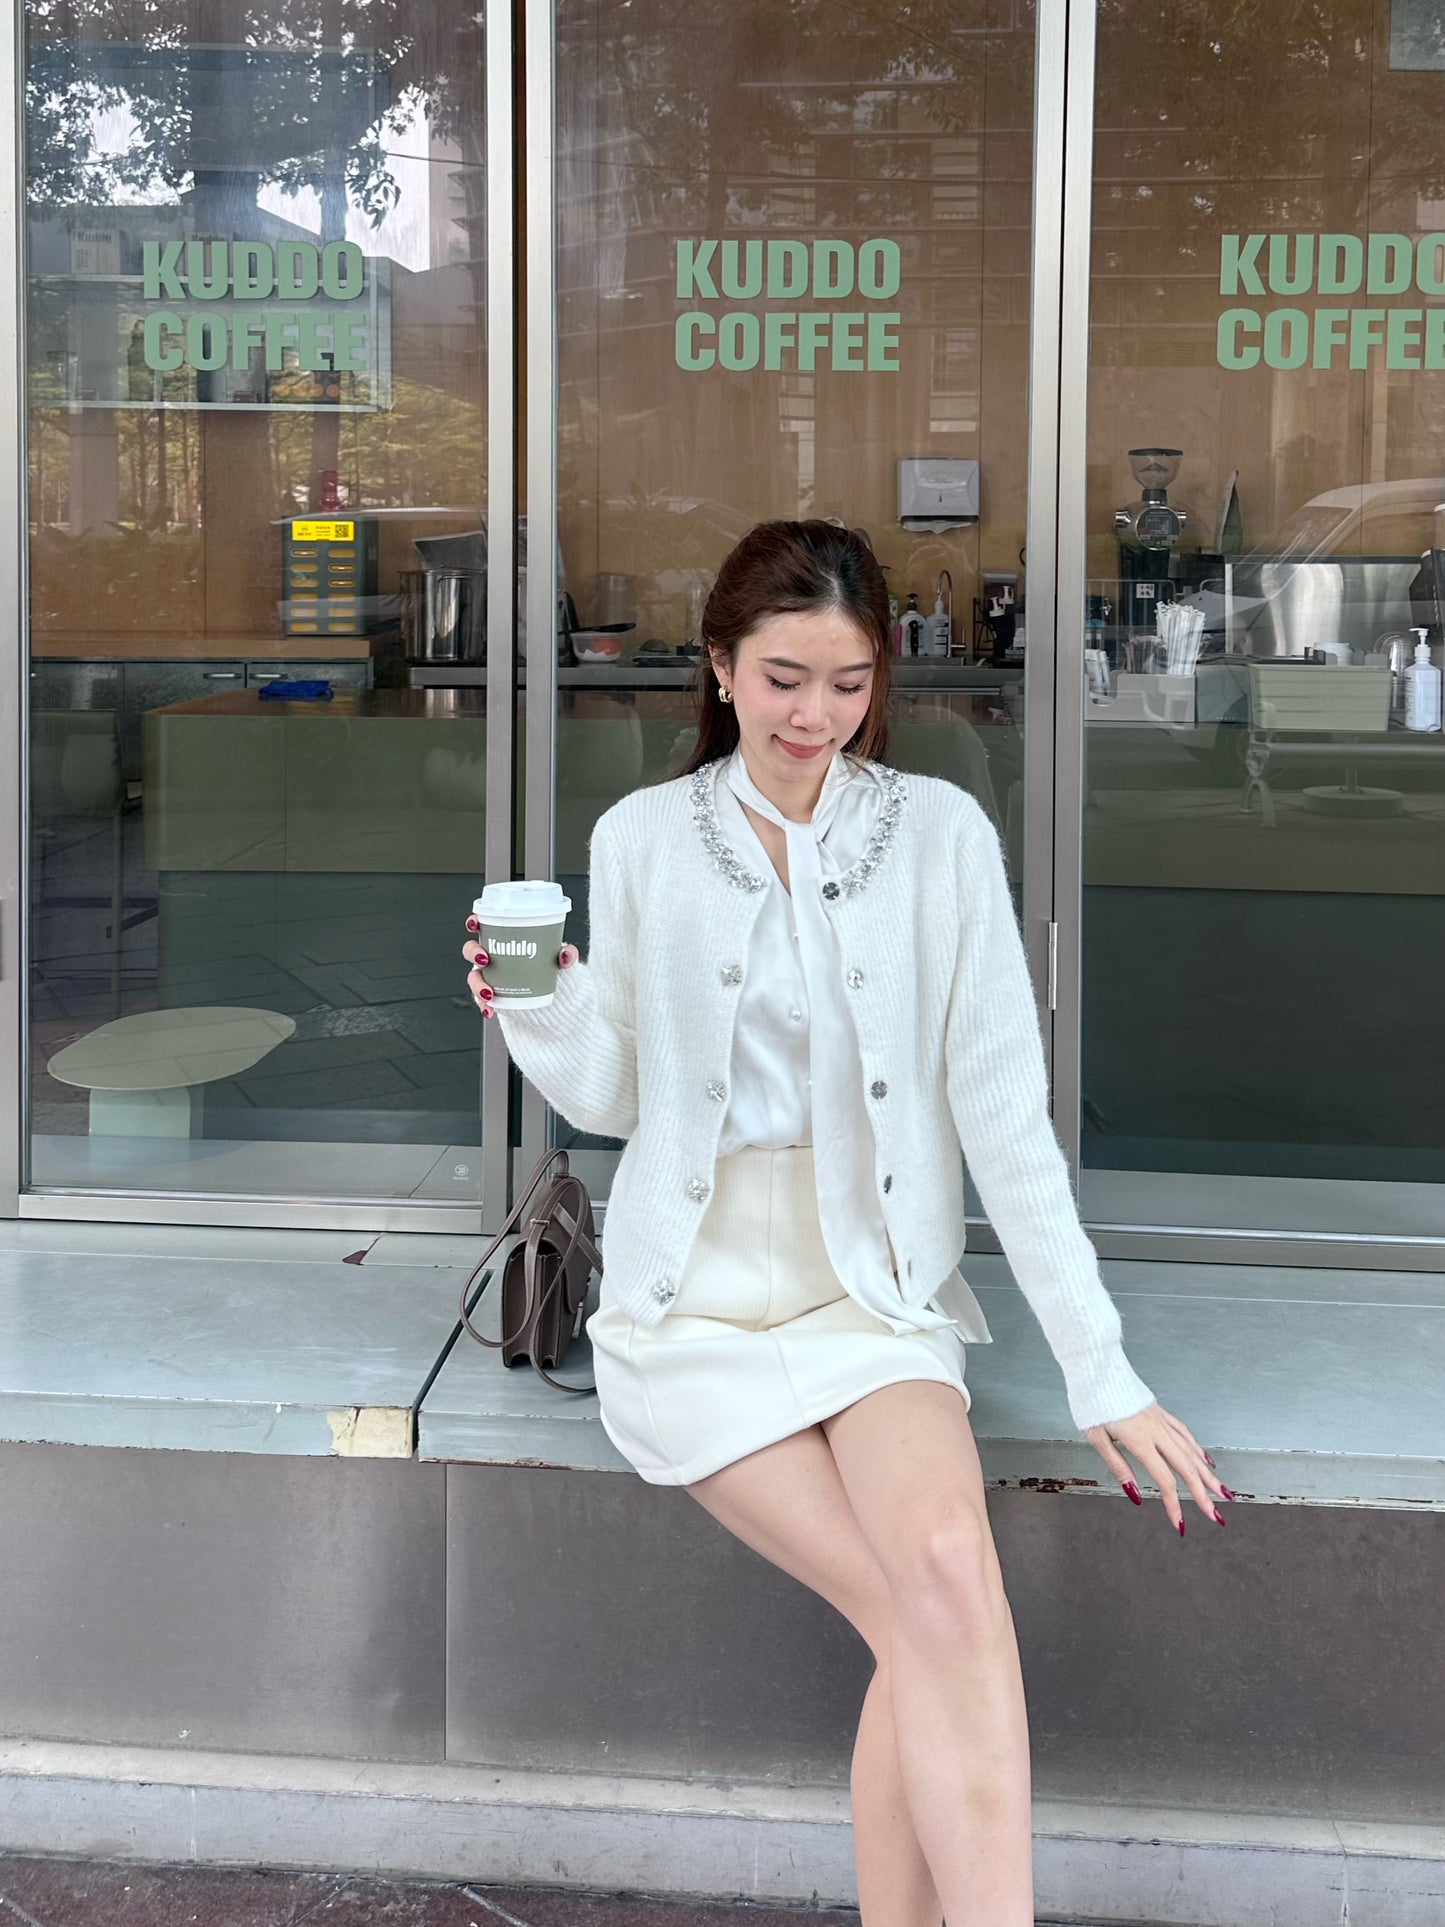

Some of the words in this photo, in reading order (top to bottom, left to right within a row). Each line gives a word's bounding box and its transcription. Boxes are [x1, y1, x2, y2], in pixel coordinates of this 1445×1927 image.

[143, 241, 364, 300] KUDDO
[677, 239, 901, 298] KUDDO
[1220, 233, 1445, 295] KUDDO
[143, 311, 367, 372] COFFEE
[676, 311, 901, 371] COFFEE
